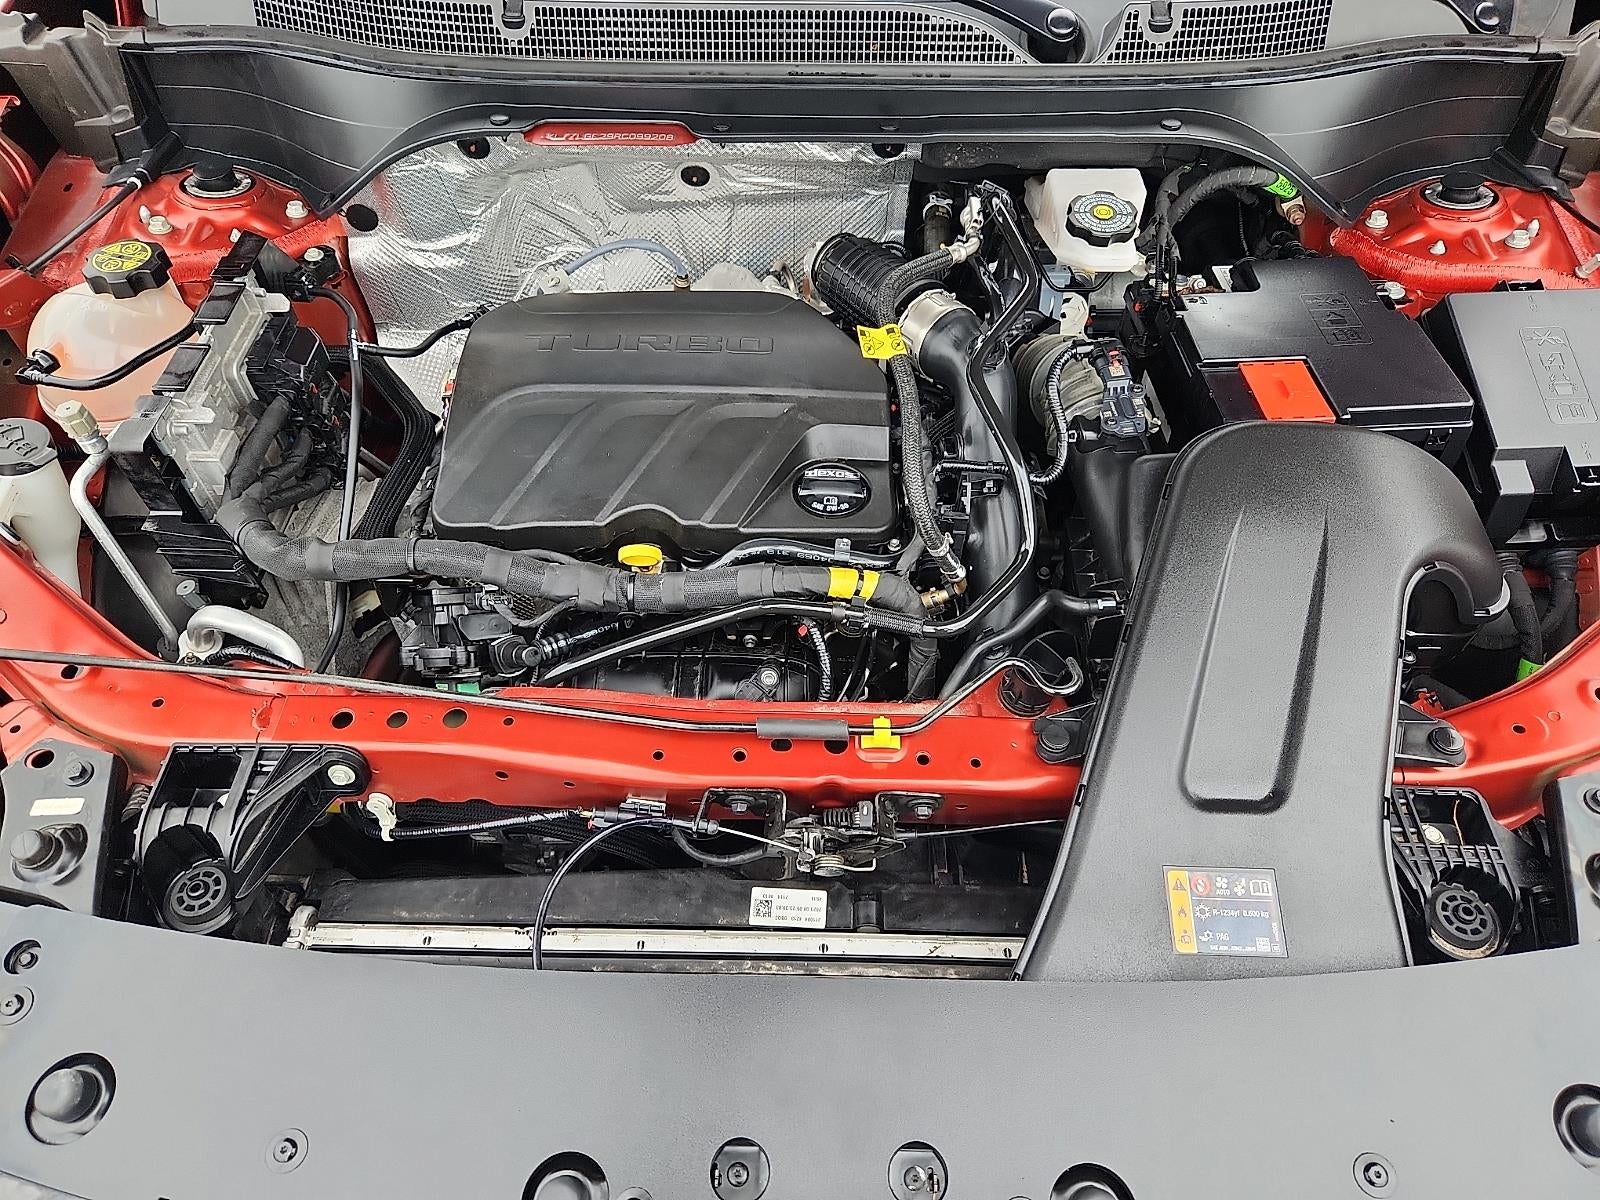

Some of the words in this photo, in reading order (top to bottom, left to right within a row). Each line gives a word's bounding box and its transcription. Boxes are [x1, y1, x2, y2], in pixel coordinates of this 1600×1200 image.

[525, 334, 774, 354] TURBO
[805, 469, 860, 479] dexos
[1216, 932, 1229, 941] PAG
